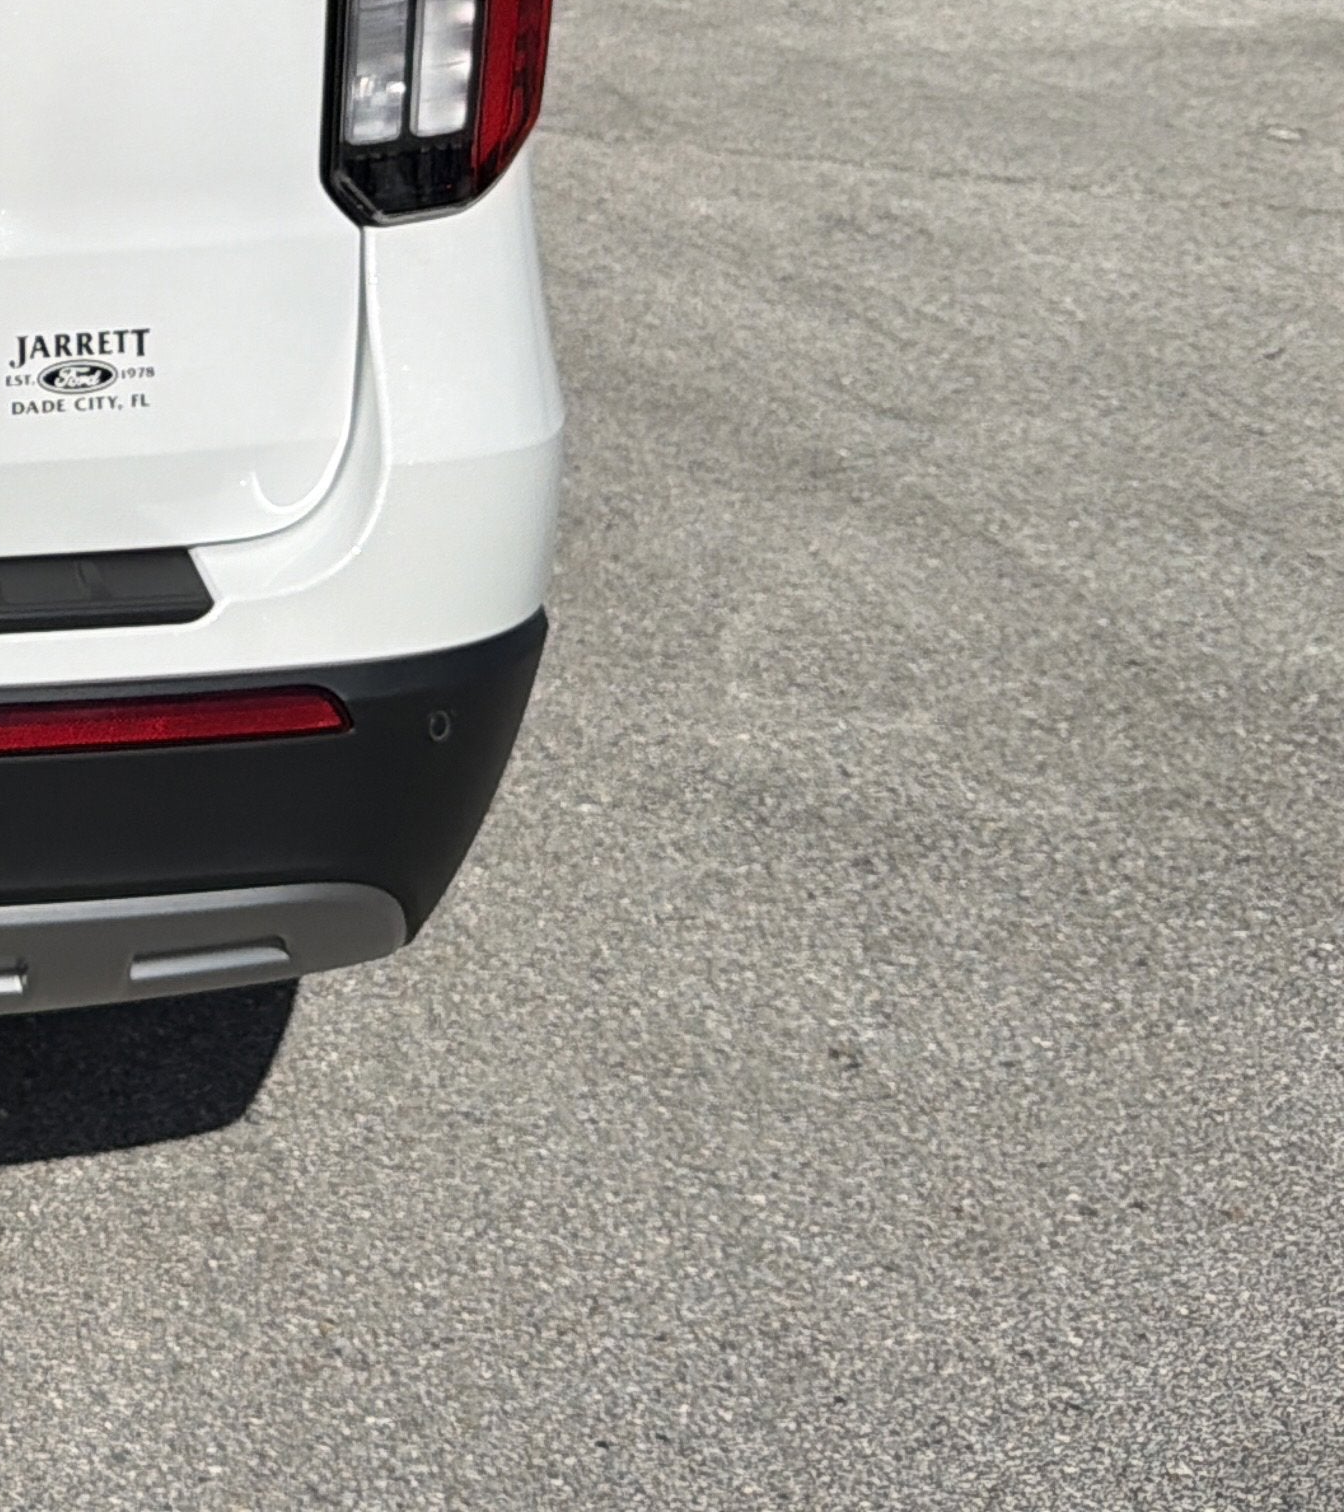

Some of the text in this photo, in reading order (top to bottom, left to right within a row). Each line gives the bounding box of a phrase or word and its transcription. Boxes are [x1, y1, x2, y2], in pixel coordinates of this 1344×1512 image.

[9, 328, 151, 369] JARRETT
[5, 374, 35, 387] EST.
[53, 364, 103, 388] Ford
[120, 366, 155, 379] 1978
[11, 393, 150, 415] DADE CITY, FL
